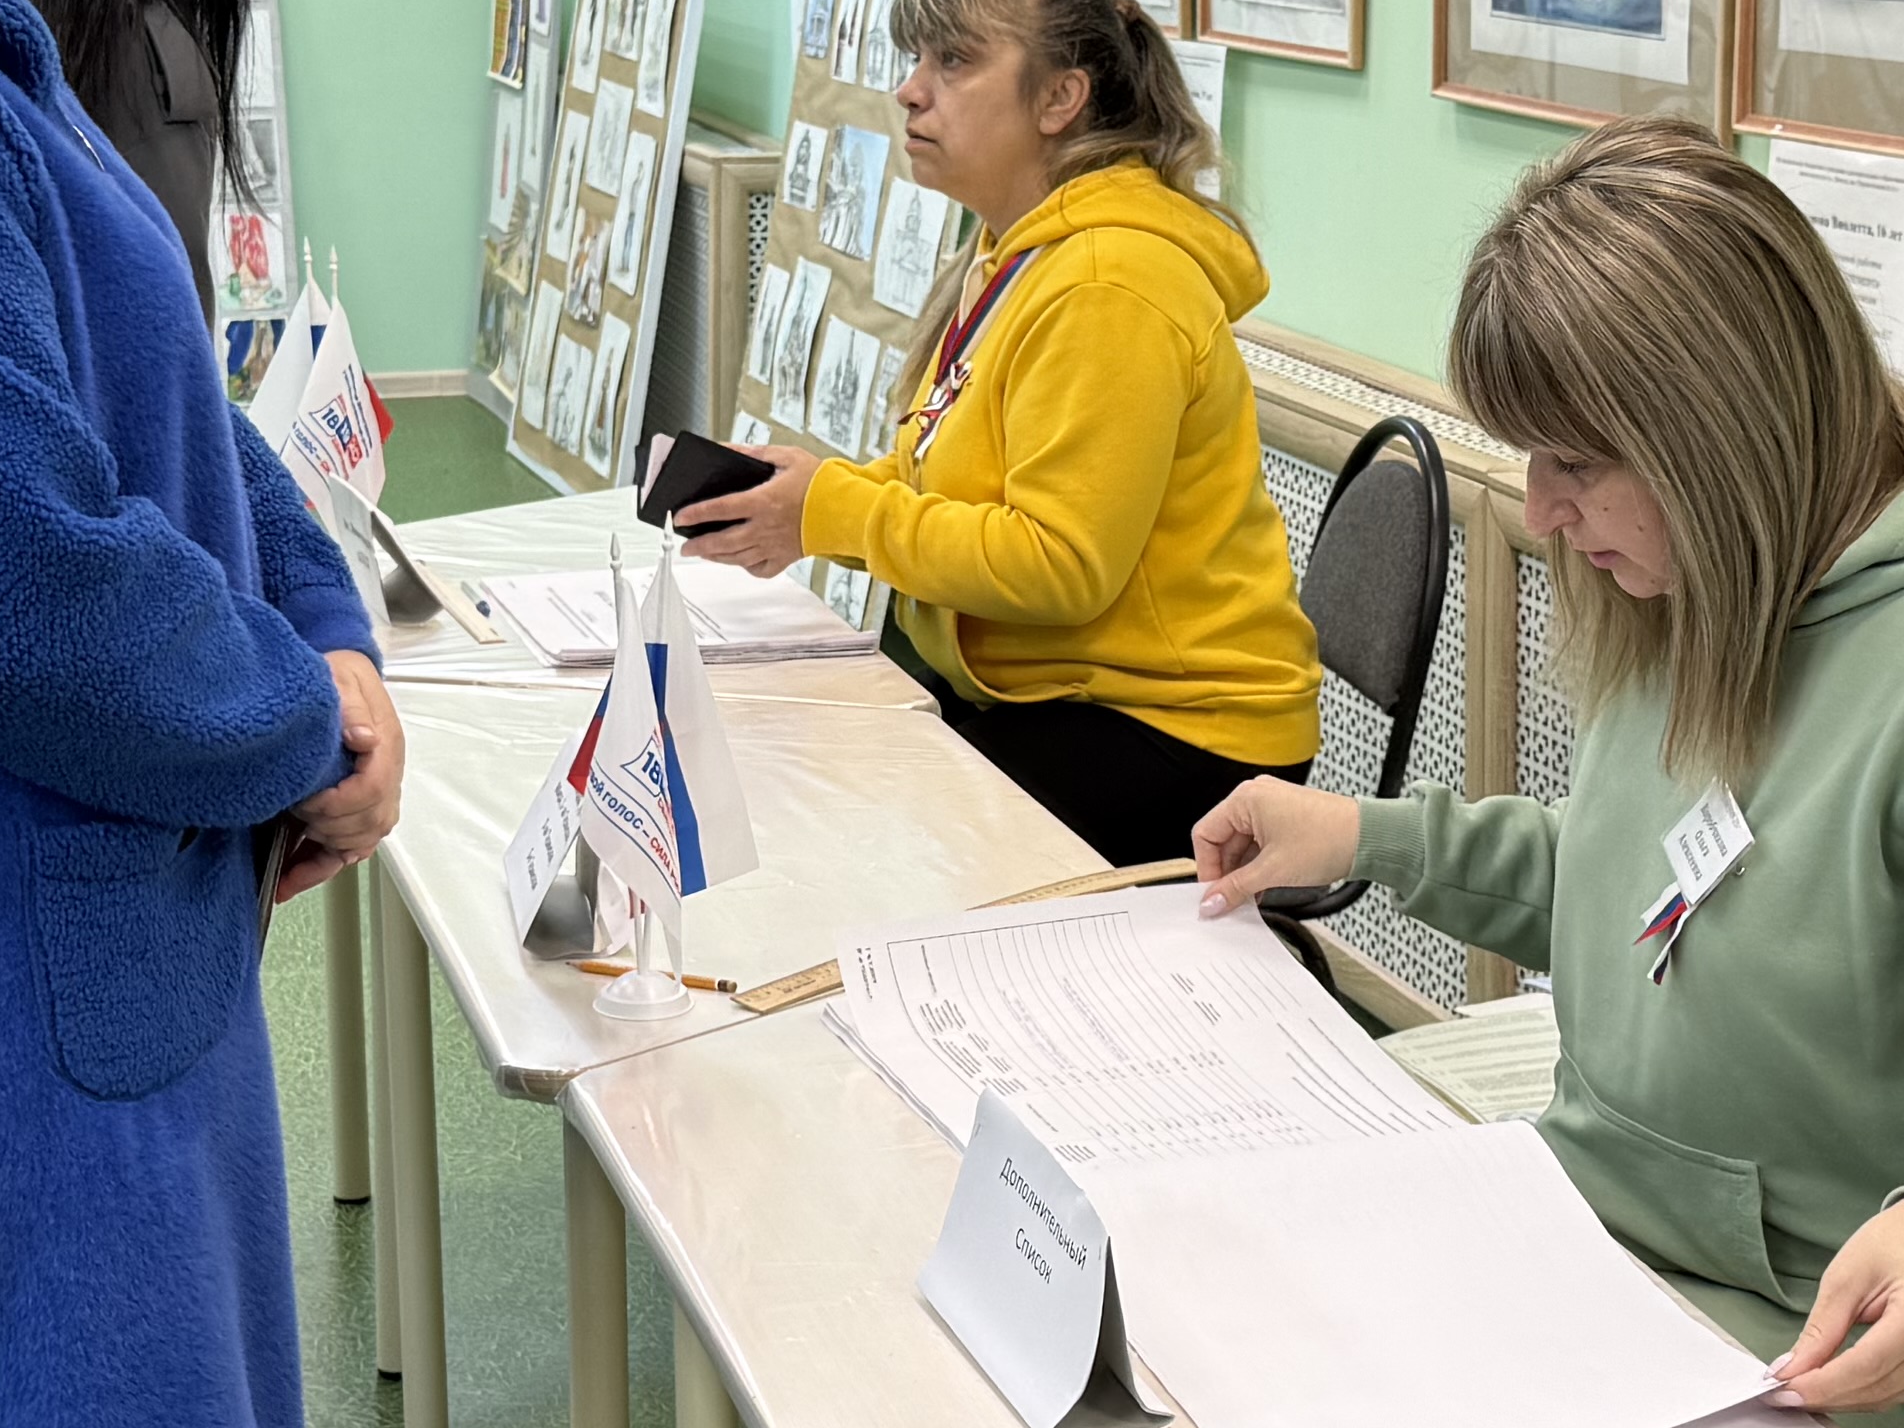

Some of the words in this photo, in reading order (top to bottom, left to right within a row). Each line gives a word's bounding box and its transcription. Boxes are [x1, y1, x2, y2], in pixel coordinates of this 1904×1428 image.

[641, 750, 663, 786] 18
[602, 790, 644, 830] ГОЛОС
[998, 1157, 1088, 1271] Дополнительный
[1015, 1227, 1053, 1284] Список
